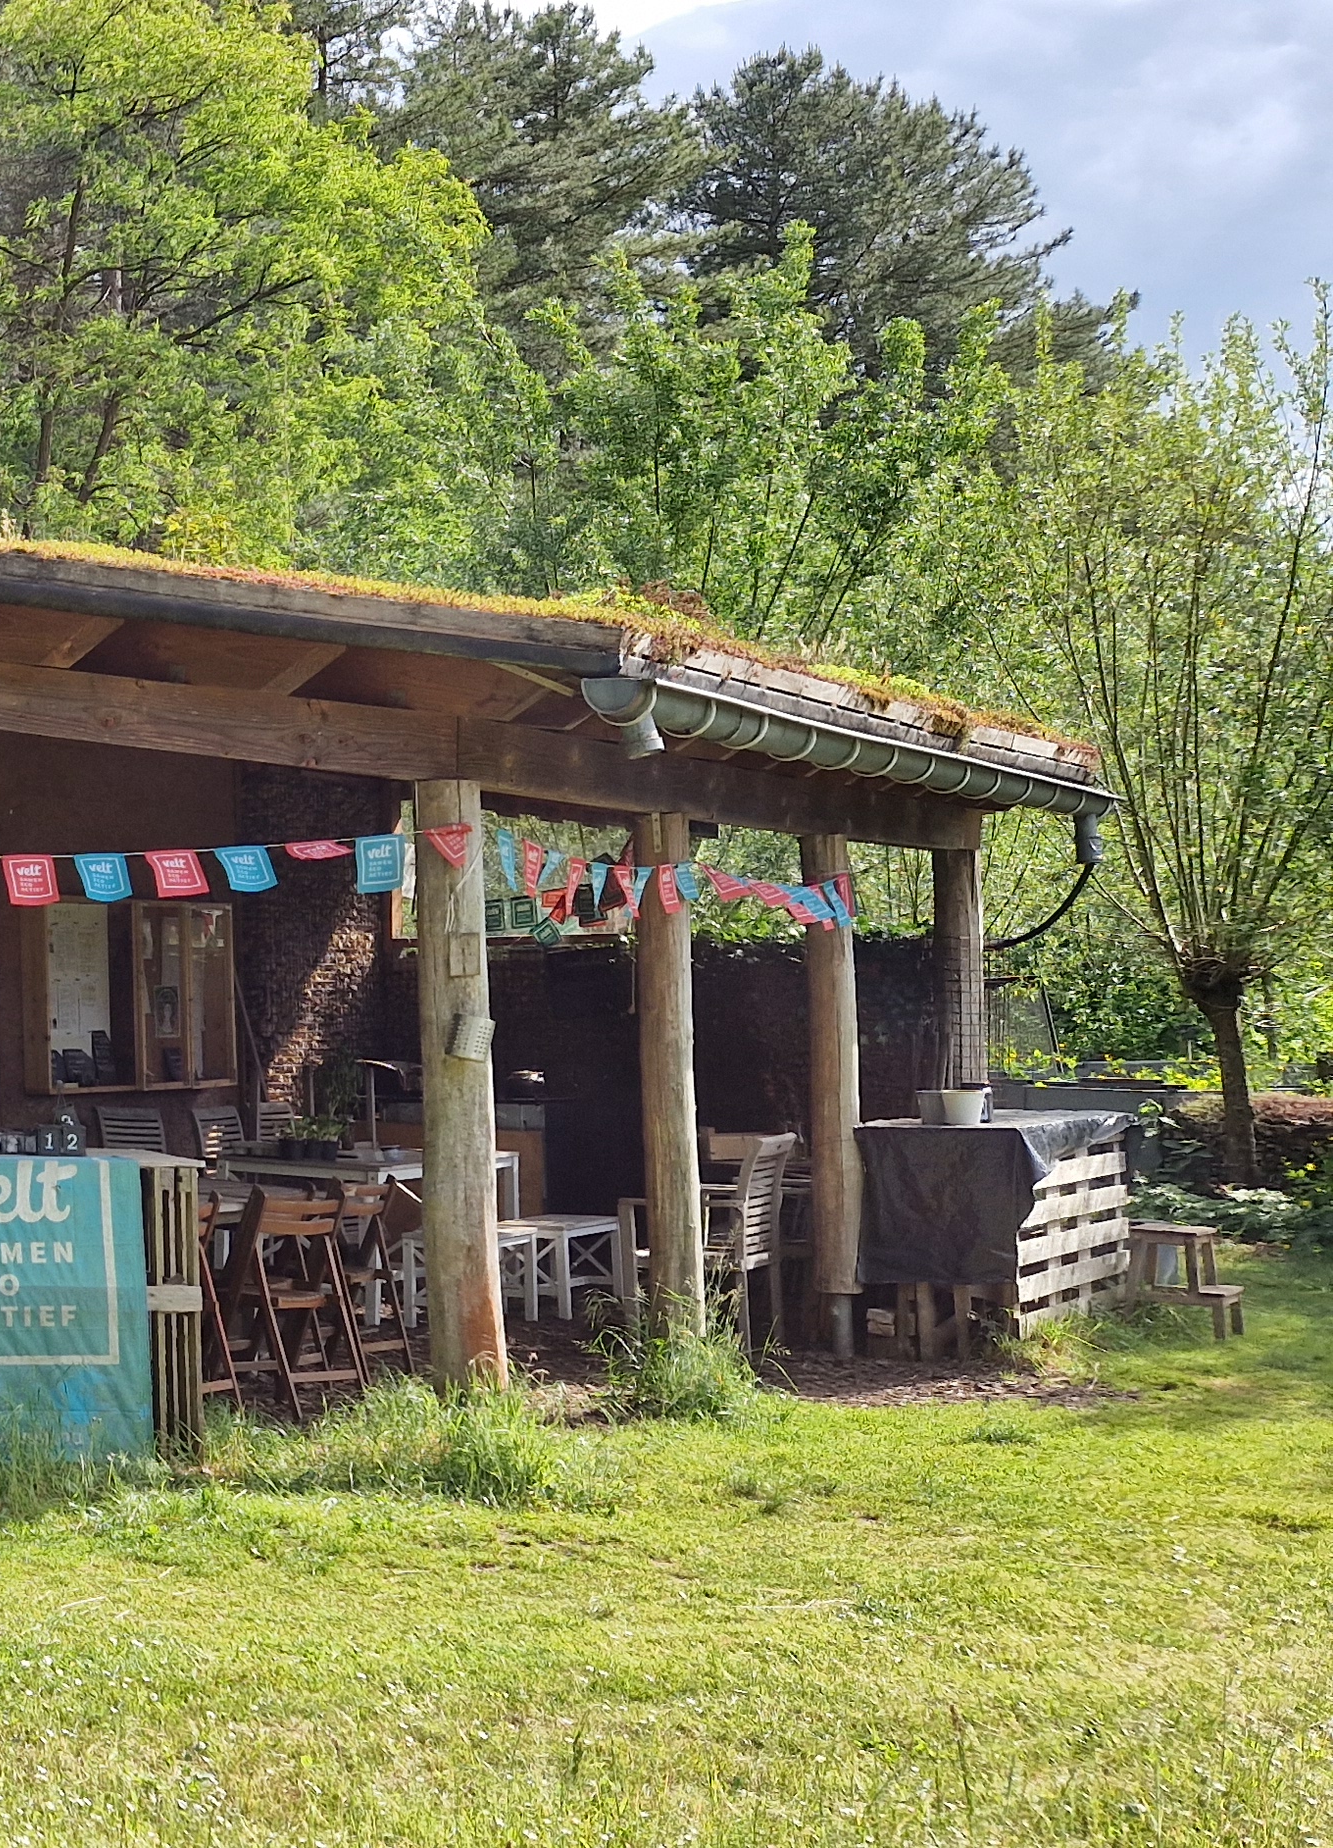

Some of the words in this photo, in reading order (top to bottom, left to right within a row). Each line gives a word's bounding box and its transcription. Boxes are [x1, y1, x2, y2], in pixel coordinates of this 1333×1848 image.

[367, 845, 392, 859] velt
[162, 857, 186, 868] velt
[231, 854, 255, 865] velt
[16, 864, 42, 876] velt
[89, 861, 112, 873] velt
[45, 1132, 54, 1150] 1
[66, 1133, 78, 1150] 2
